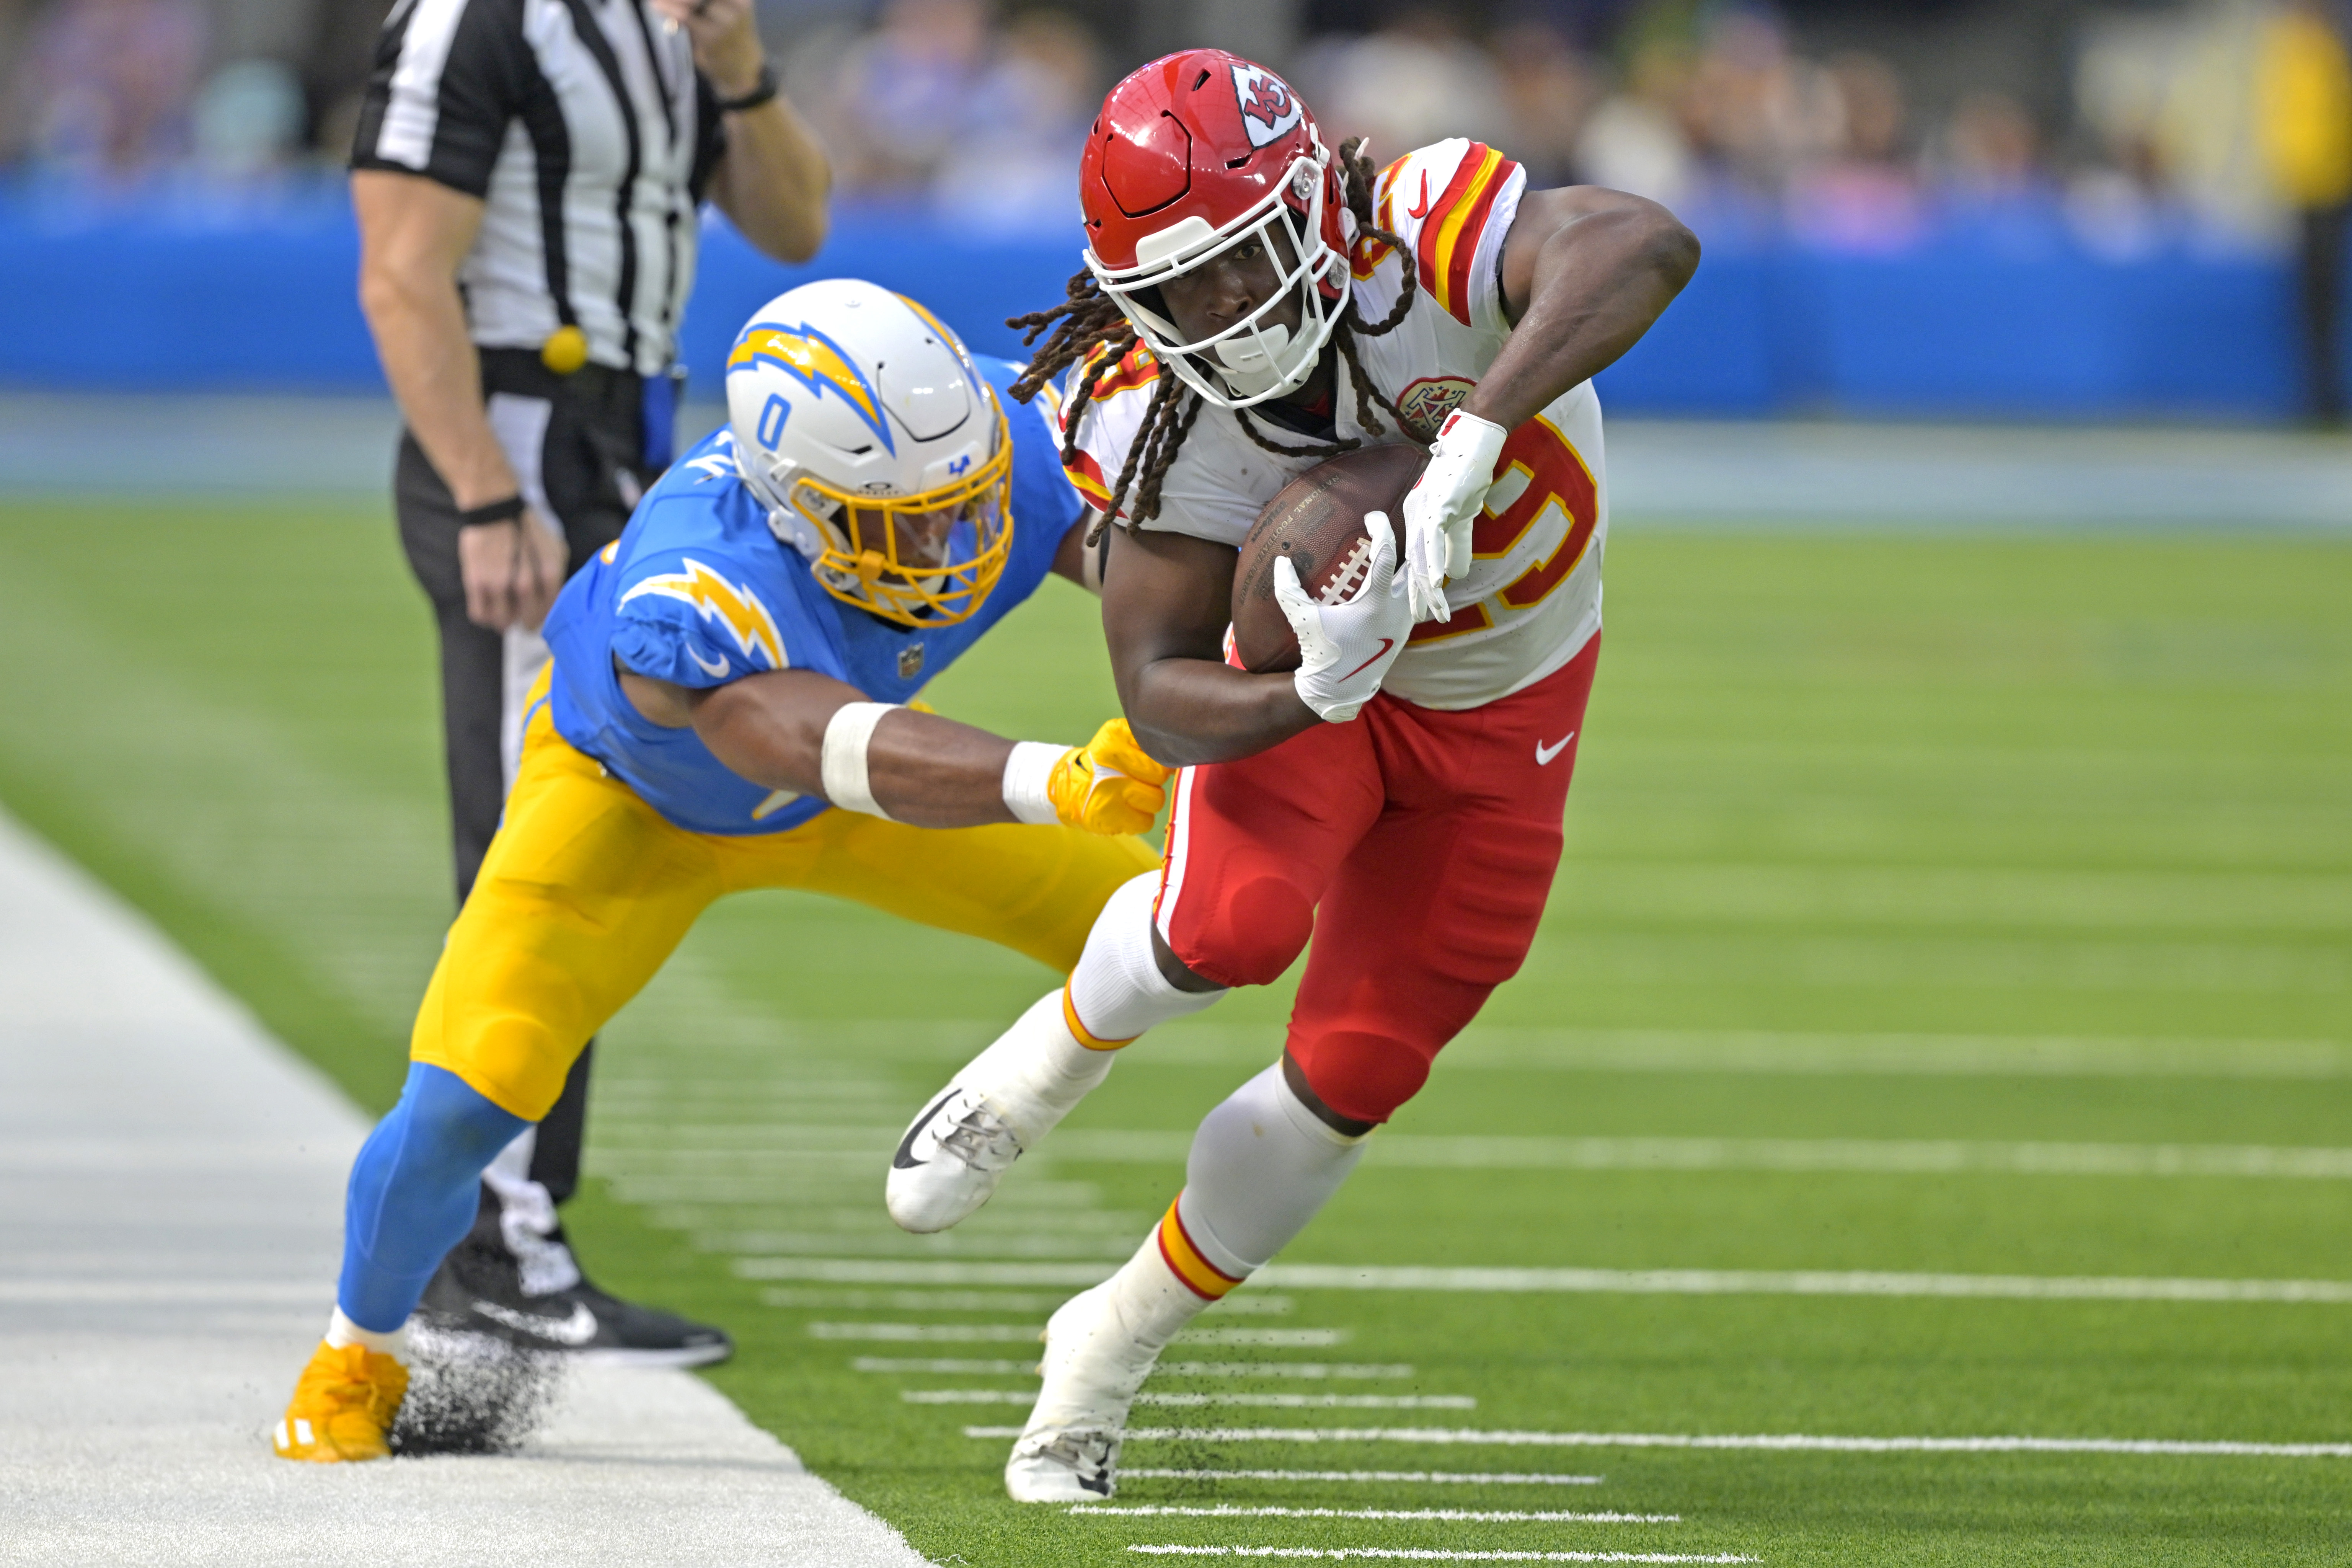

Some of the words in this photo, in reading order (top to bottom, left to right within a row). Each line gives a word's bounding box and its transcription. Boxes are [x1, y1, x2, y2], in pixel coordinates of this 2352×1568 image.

[1244, 75, 1292, 130] KC
[757, 393, 791, 452] 0
[1294, 475, 1340, 513] NATIONAL
[1256, 515, 1294, 564] FOOTBALL
